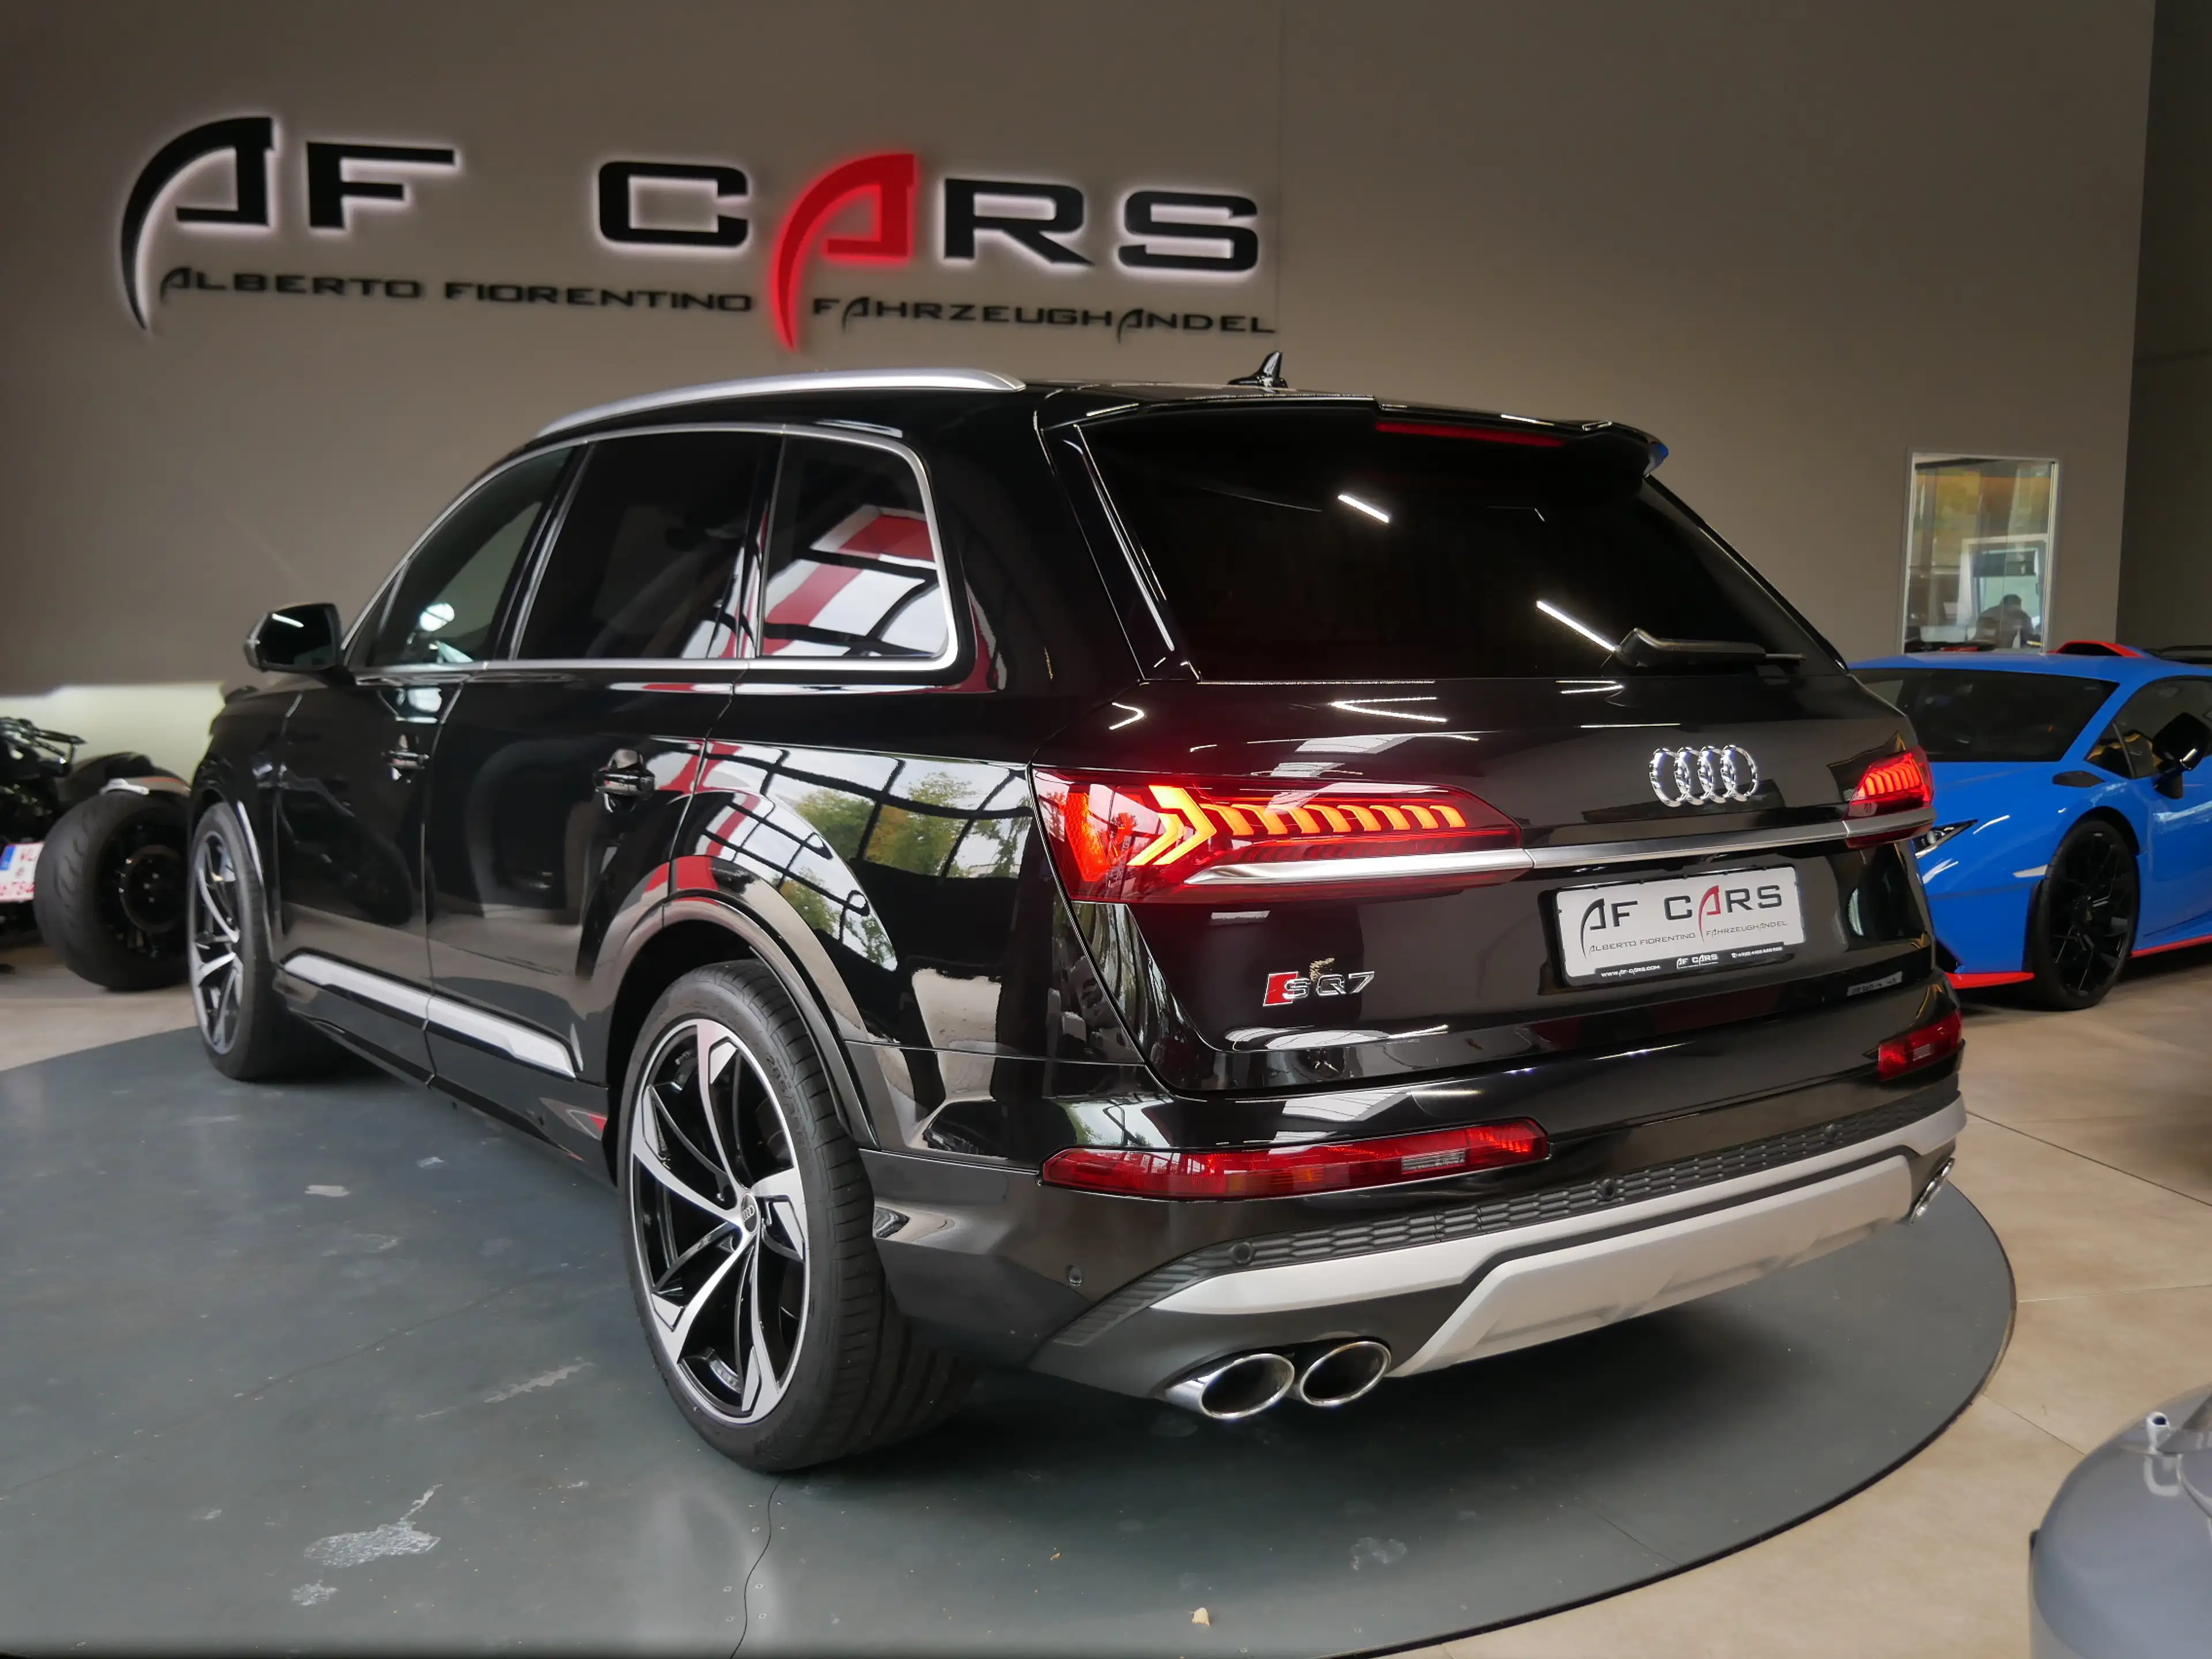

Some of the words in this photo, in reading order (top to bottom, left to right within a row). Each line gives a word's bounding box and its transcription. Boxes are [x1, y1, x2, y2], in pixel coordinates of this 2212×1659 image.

[121, 116, 455, 330] AF
[598, 153, 1259, 353] CARS
[160, 267, 422, 303] ALBERTO
[445, 281, 753, 312] FIORENTINO
[813, 296, 1277, 343] FAHRZEUGHANDEL
[1580, 898, 1638, 959] AF
[1664, 885, 1782, 942] CARS
[1589, 941, 1637, 956] ALBERTO
[1640, 933, 1695, 945] FIORENTINO
[1706, 921, 1787, 937] FAHRZEUGHANDEL
[1282, 971, 1375, 1000] SQ7
[1676, 957, 1689, 969] AF
[1691, 954, 1718, 966] CARS
